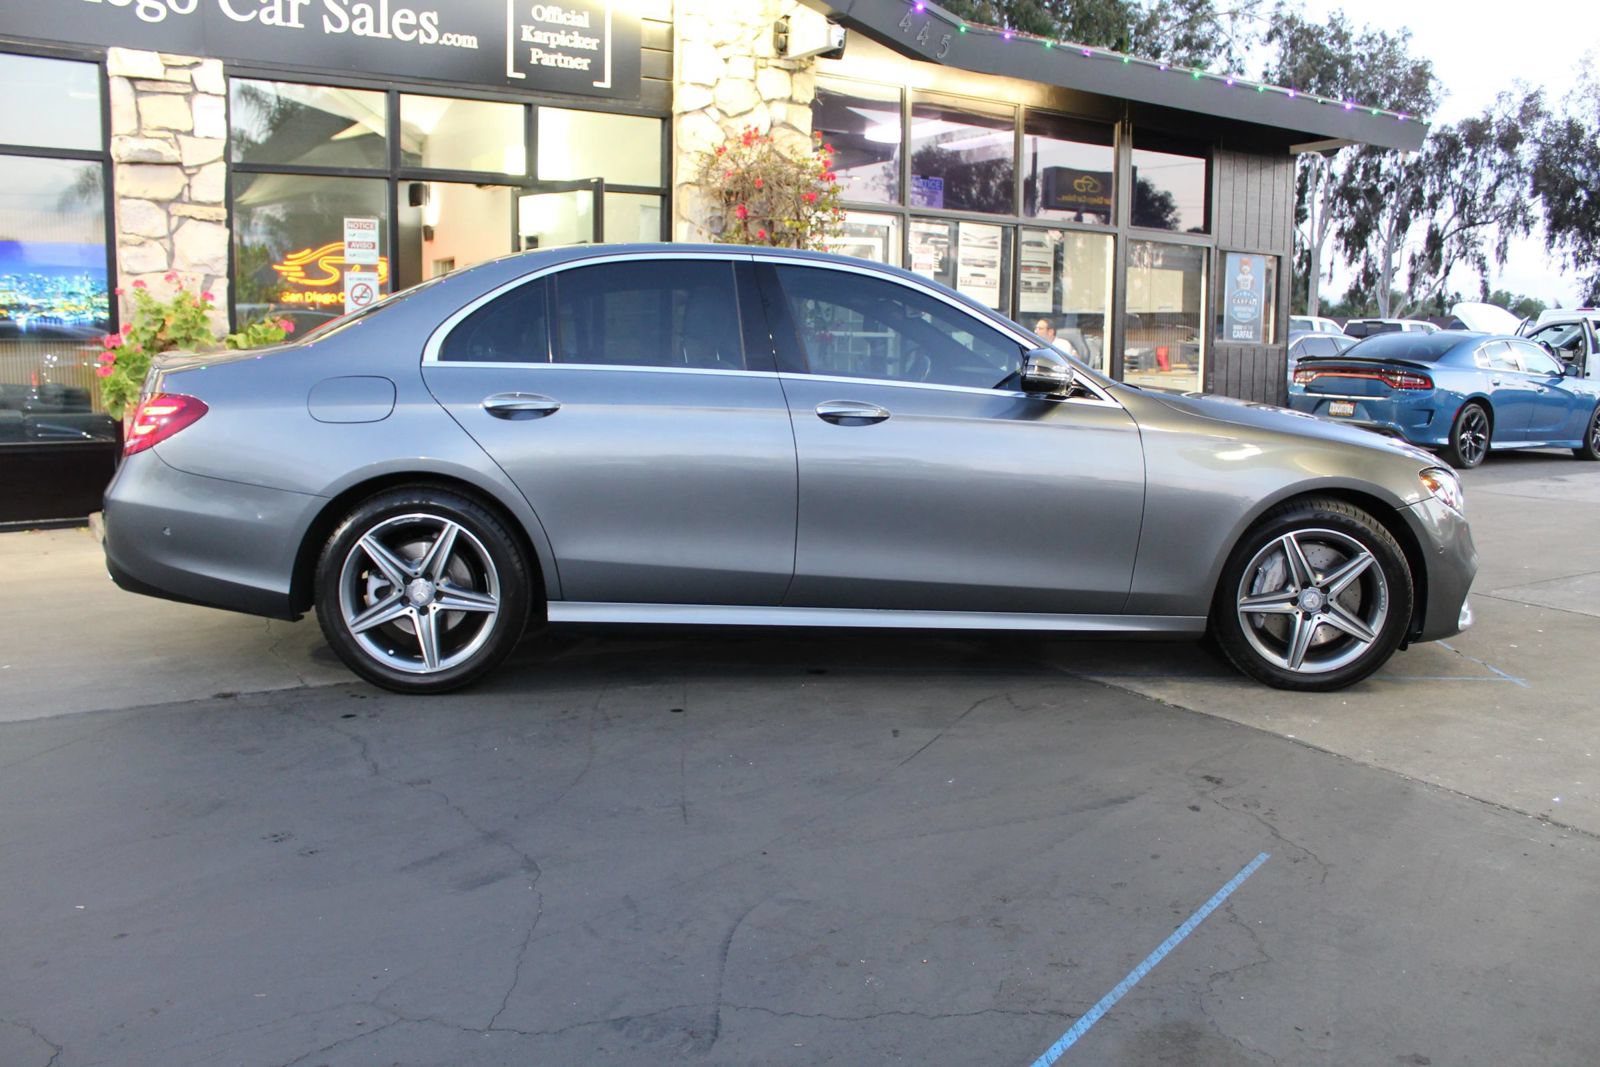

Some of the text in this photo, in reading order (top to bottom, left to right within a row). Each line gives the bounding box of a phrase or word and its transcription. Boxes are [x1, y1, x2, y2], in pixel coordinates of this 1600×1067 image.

[531, 4, 590, 28] Official
[521, 25, 600, 50] Karpicker
[529, 47, 591, 70] Partner
[347, 221, 376, 230] NOTICE
[350, 241, 374, 249] AVISO
[304, 291, 337, 304] Diego
[1232, 330, 1254, 339] CARFAX
